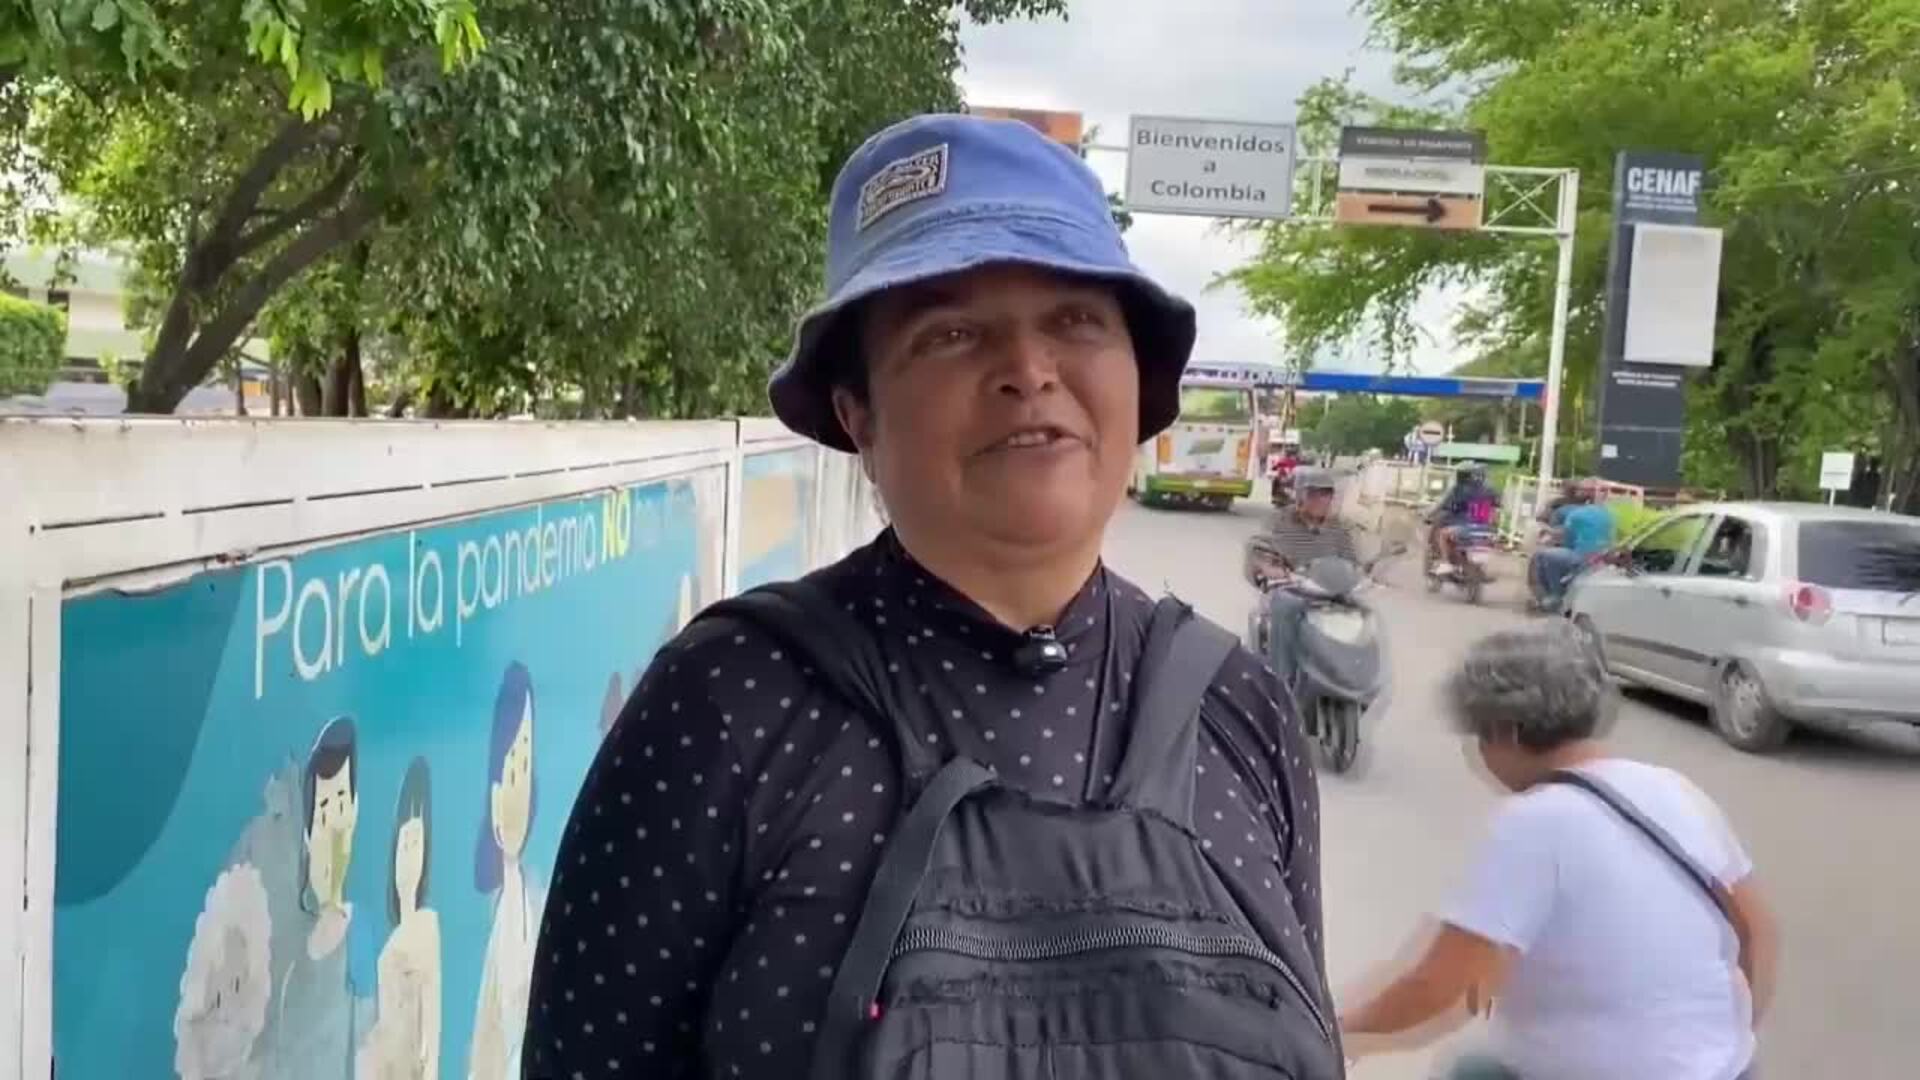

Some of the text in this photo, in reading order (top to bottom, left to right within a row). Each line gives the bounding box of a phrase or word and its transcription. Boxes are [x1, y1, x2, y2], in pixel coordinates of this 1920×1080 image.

[1136, 129, 1285, 154] Bienvenidos
[1203, 161, 1217, 174] a
[1151, 180, 1266, 202] Colombia
[1627, 166, 1702, 196] CENAF
[254, 487, 631, 700] Para la pandemia NO
